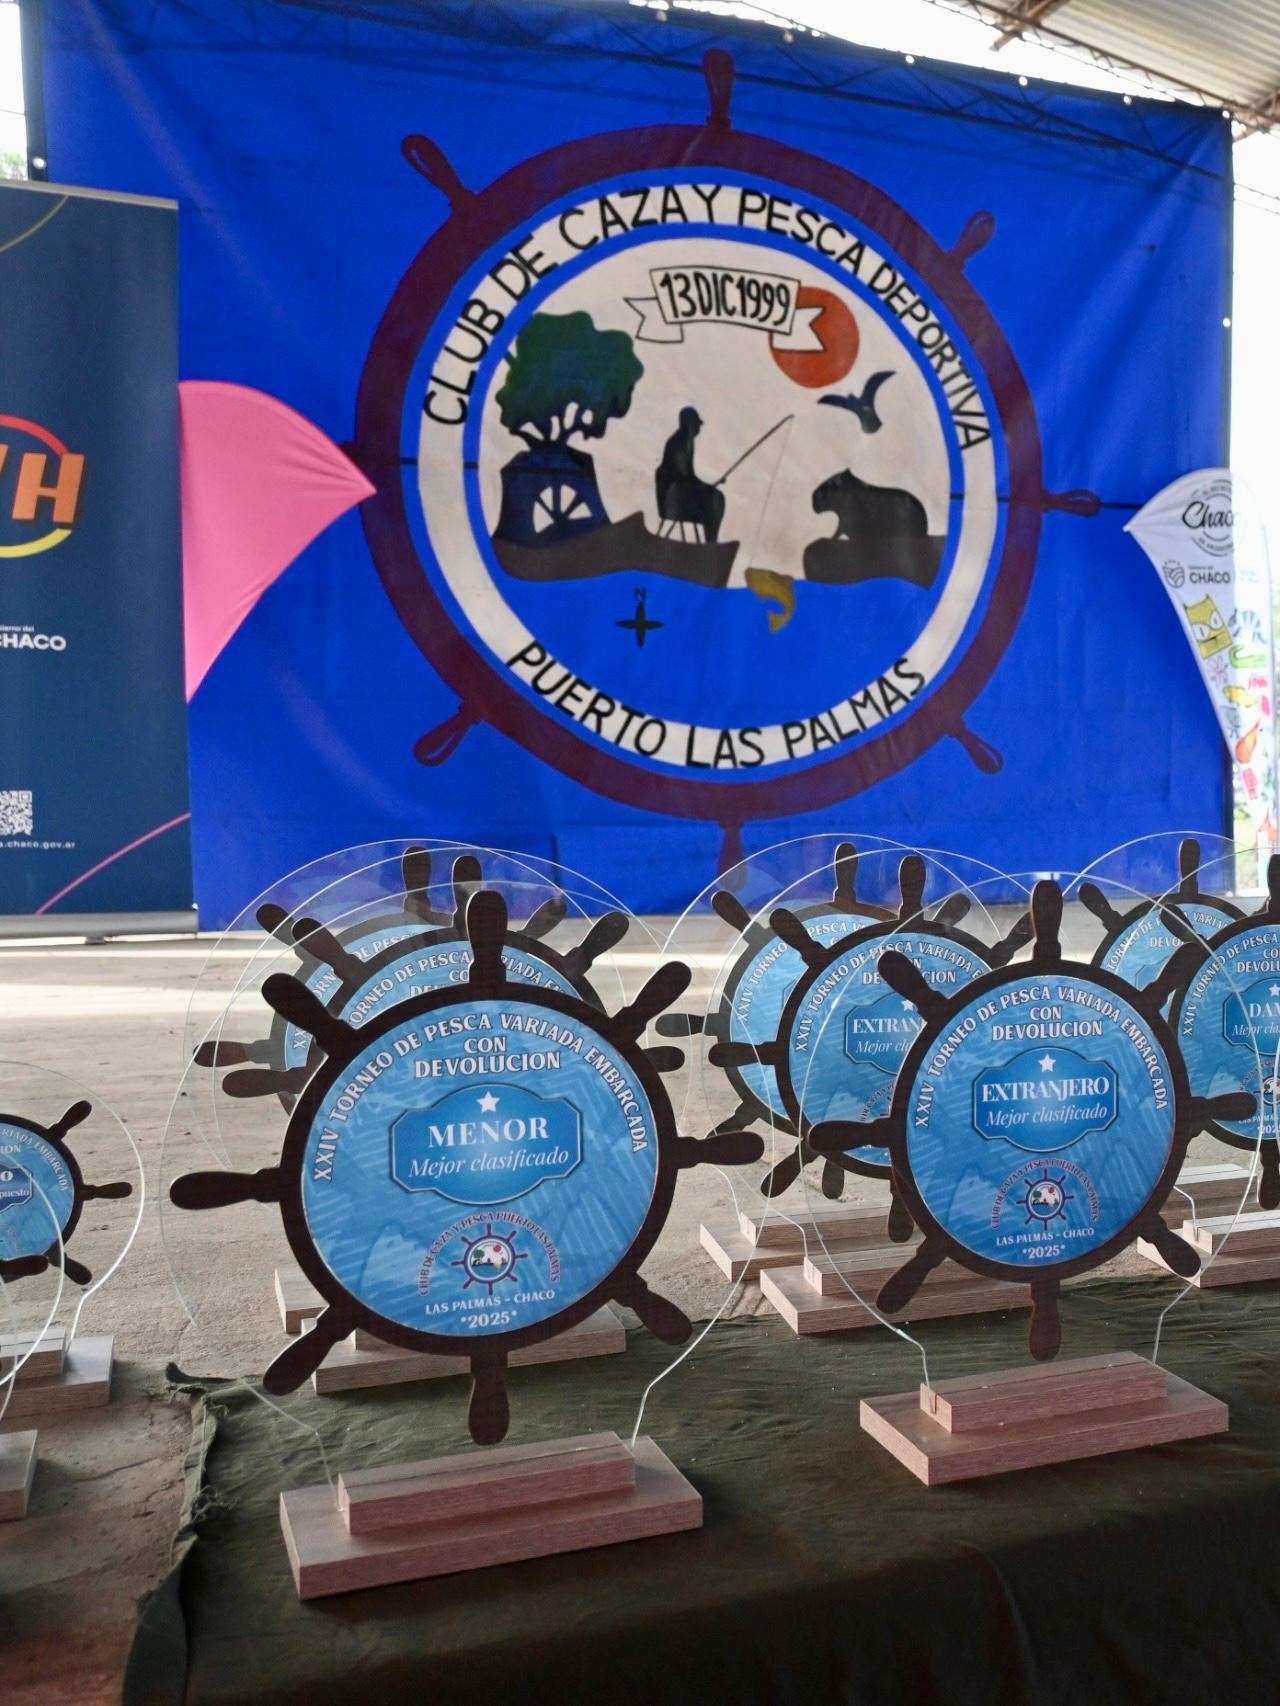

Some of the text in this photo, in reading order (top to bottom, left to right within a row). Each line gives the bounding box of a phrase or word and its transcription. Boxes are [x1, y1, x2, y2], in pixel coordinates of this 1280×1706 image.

[424, 296, 505, 426] CLUB
[491, 234, 560, 300] DE
[738, 187, 863, 275] PESCA
[867, 261, 991, 451] DEPORTIVA
[1189, 571, 1231, 584] CHACO
[506, 640, 926, 769] PUERTO LAS PALMAS
[394, 951, 472, 984] DE PESCA
[751, 941, 789, 985] TORNEO
[807, 922, 848, 937] PESCA
[796, 1016, 812, 1052] XXIV
[808, 964, 850, 1014] TORNEO
[850, 952, 866, 969] DE
[918, 942, 973, 972] VARIADA
[1182, 1003, 1197, 1037] XXIV
[1193, 954, 1226, 999] TORNEO
[1226, 942, 1241, 959] DE
[1242, 933, 1278, 950] PESCA
[1029, 1006, 1063, 1021] CON
[992, 1020, 1103, 1041] DEVOLUCION
[1232, 1022, 1263, 1037] Mejor
[463, 1037, 507, 1054] CON
[856, 1040, 893, 1055] Mejor
[914, 1082, 936, 1128] XXIV
[927, 1016, 977, 1078] TORNEO
[976, 1000, 998, 1021] DE
[999, 985, 1051, 1010] PESCA
[1056, 985, 1122, 1023] VARIADA
[1119, 1017, 1169, 1111] EMBARCADA
[415, 1051, 562, 1078] DEVOLUCION
[313, 1012, 649, 1182] XXIV TORNEO DE PESCA VARIADA EMBARCADA
[981, 1076, 1110, 1102] EXTRANJERO
[985, 1102, 1108, 1128] Mejor clasificado
[427, 1116, 549, 1148] MENOR
[33, 1141, 69, 1191] EMBARCADA
[408, 1147, 570, 1179] Mejor clasificado
[996, 1227, 1095, 1246] LAS PALMAS CHACO
[425, 1289, 556, 1315] LAS PALMAS CHACO
